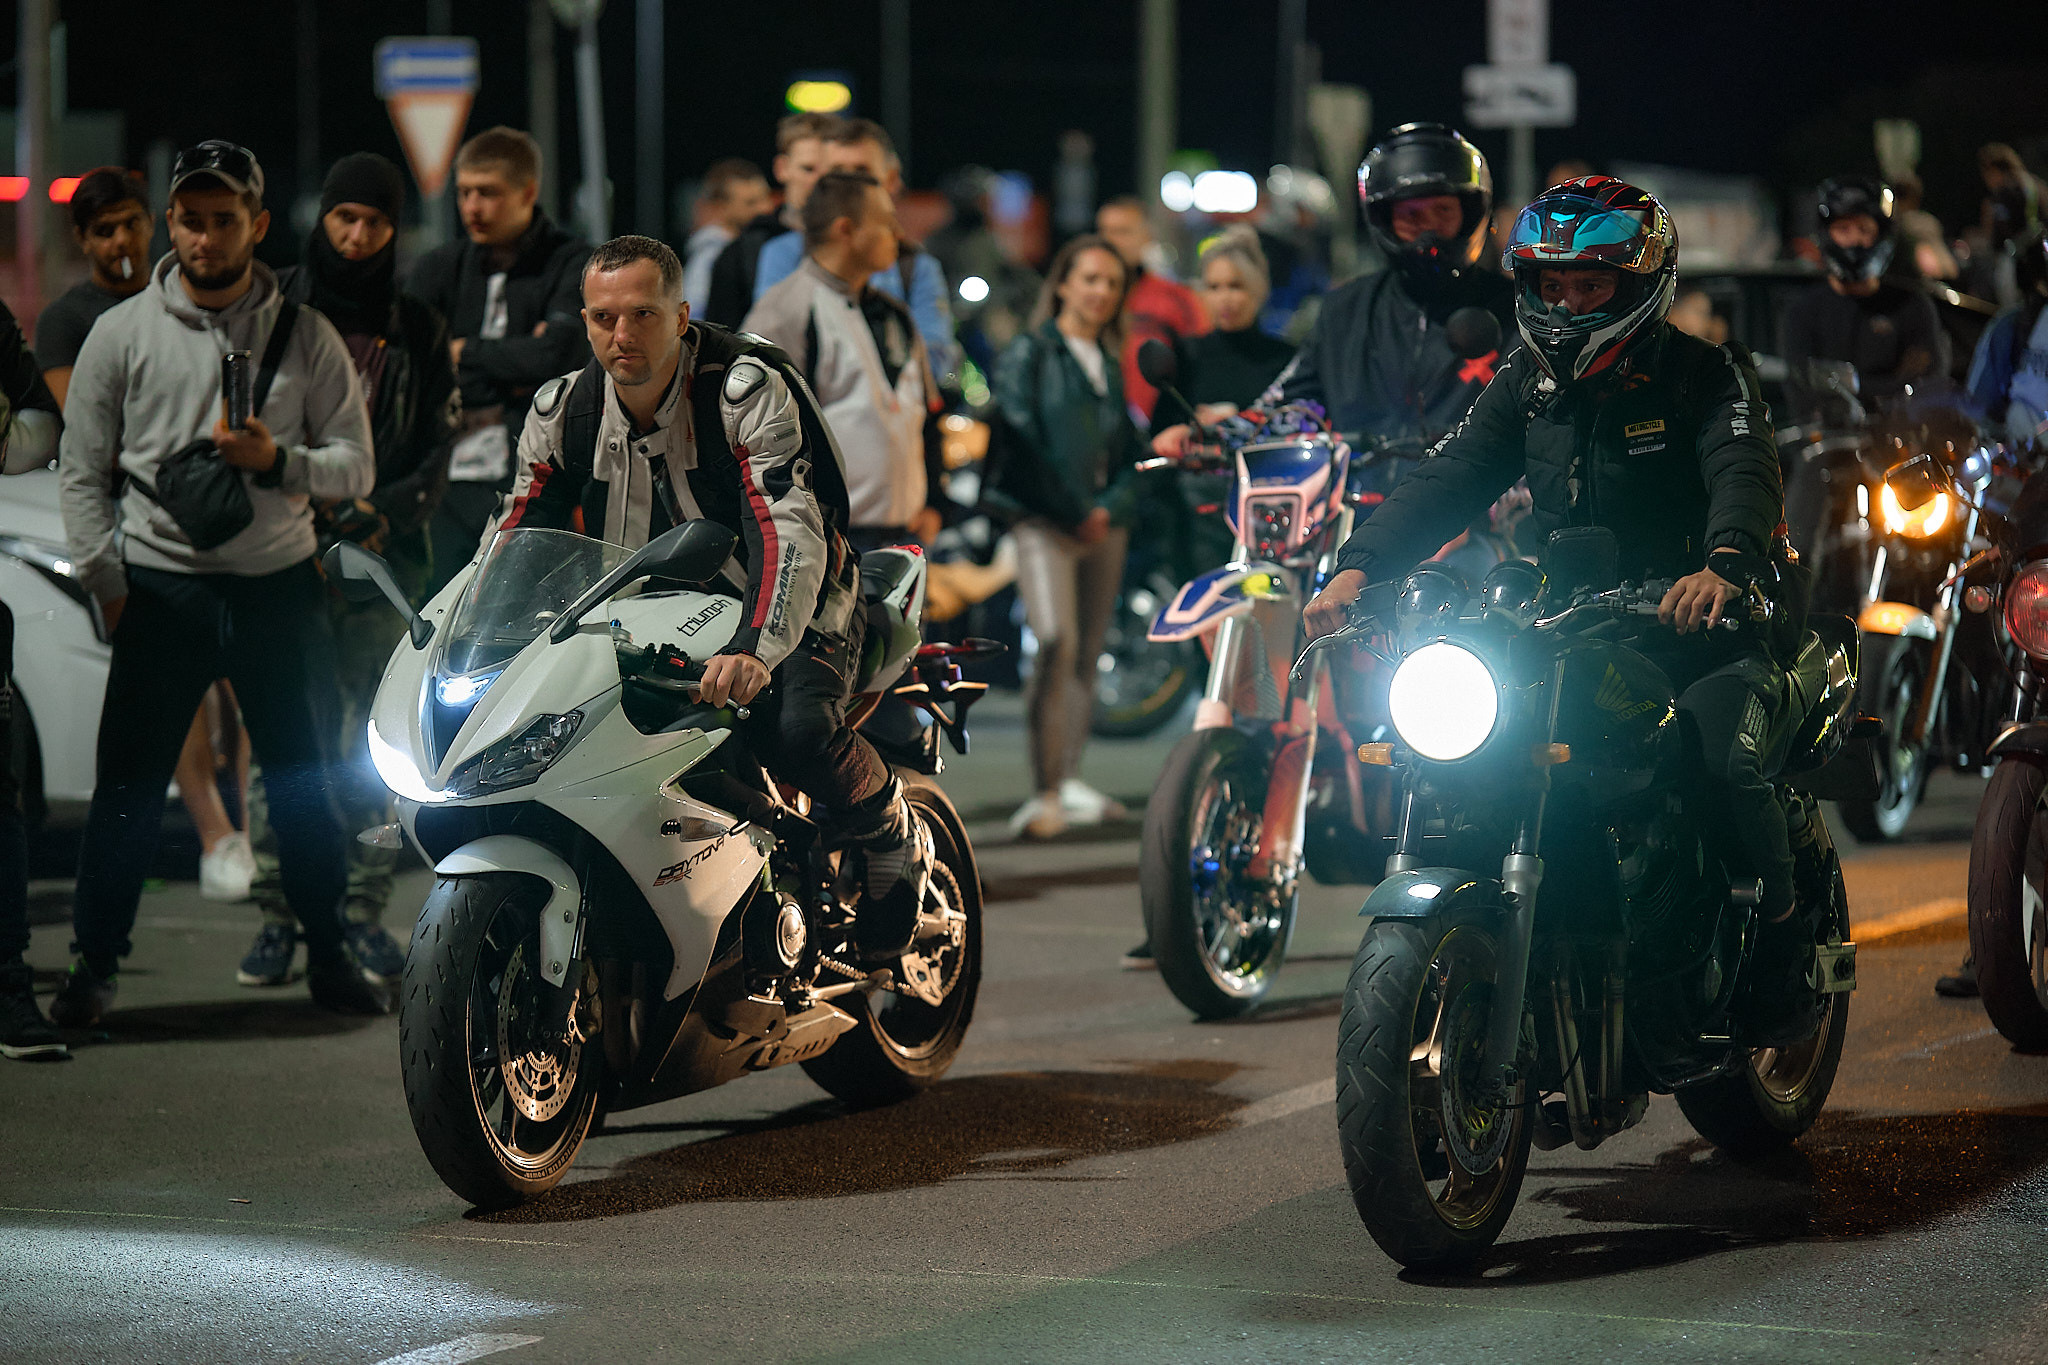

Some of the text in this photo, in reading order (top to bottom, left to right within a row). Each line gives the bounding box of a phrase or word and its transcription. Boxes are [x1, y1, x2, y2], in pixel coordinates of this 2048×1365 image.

[1627, 420, 1662, 433] MOTORCYCLE
[769, 542, 797, 637] KOMINE
[787, 550, 803, 598] INNOVATION
[676, 599, 733, 637] triumph
[657, 835, 725, 880] DAYTONA
